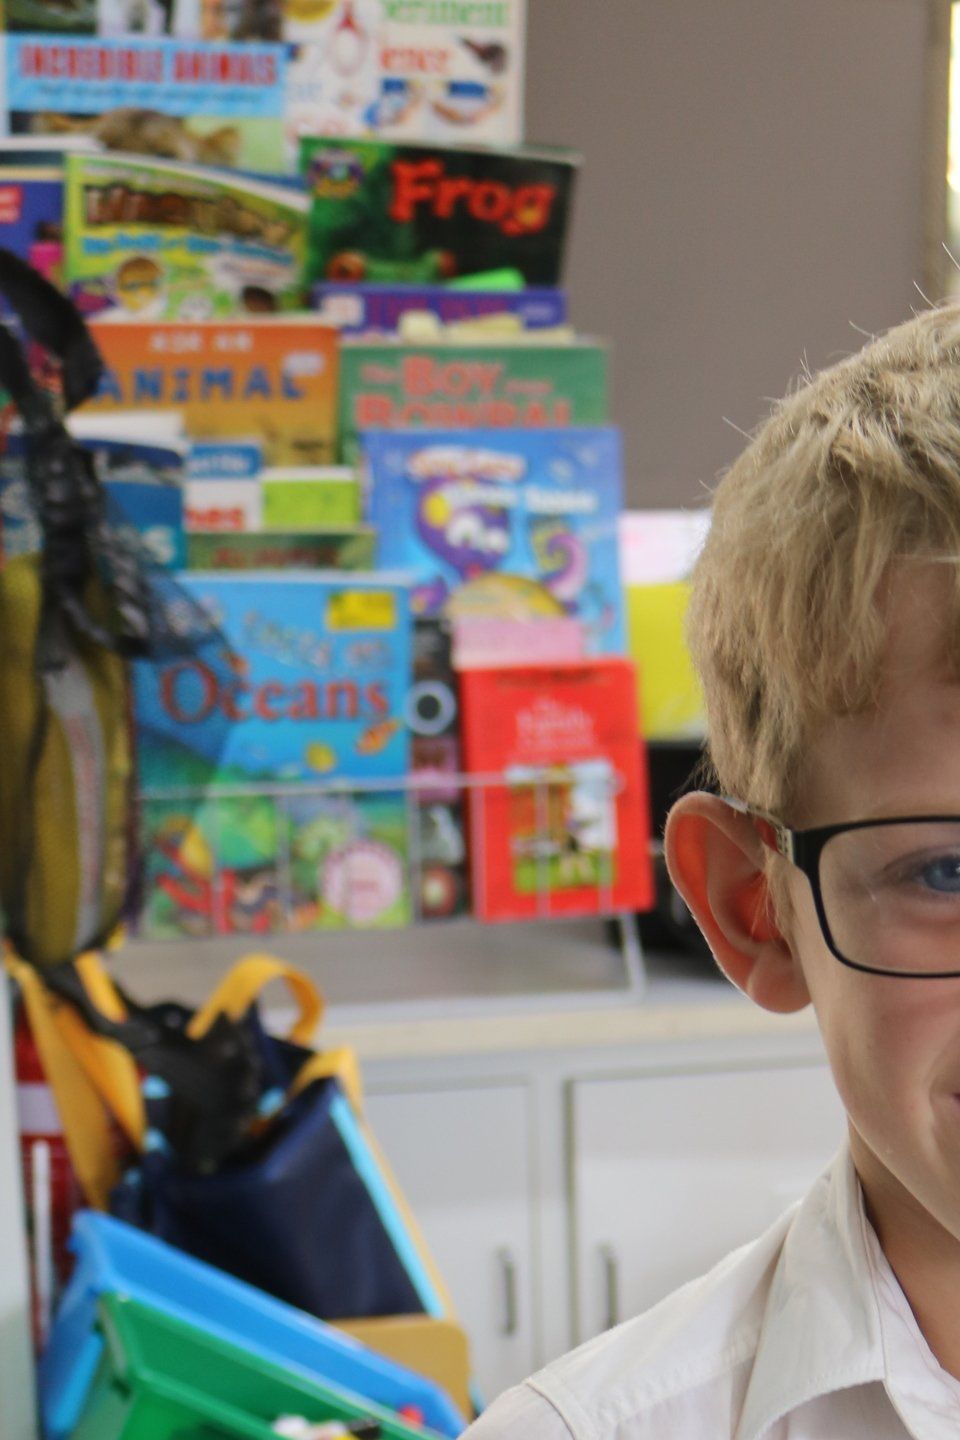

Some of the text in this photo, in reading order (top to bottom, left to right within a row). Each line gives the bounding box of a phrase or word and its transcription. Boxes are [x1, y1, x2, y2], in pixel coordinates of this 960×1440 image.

[19, 43, 277, 87] INCREDIBLE ANIMALS
[390, 158, 557, 237] Frog
[91, 364, 306, 404] ANIMAL
[159, 656, 391, 726] Oceans
